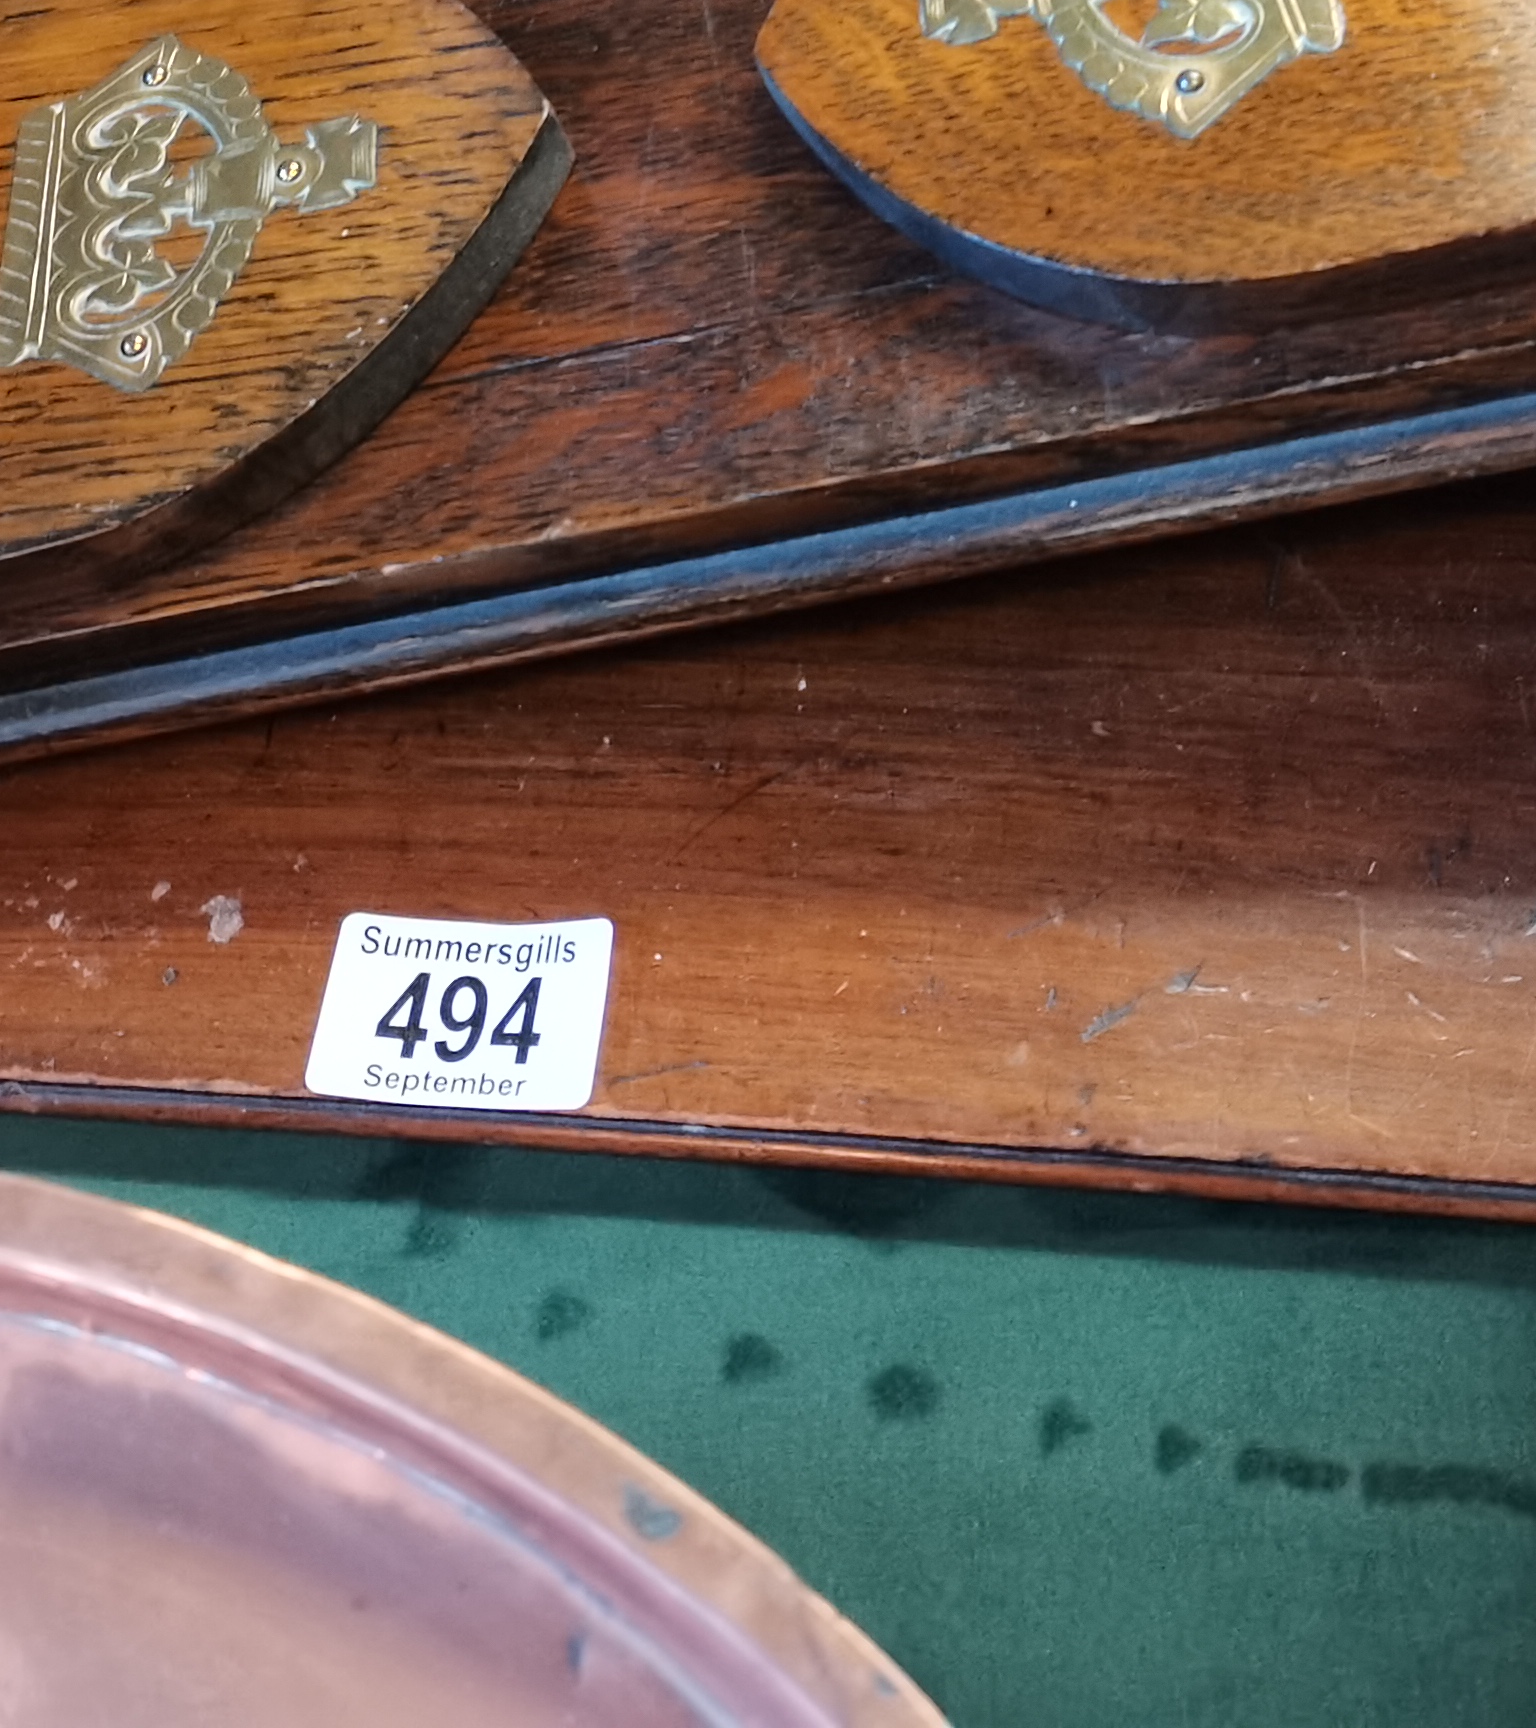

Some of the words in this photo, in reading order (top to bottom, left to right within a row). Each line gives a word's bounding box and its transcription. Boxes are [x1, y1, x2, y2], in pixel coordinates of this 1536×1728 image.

[360, 925, 577, 973] Summersgills
[374, 972, 543, 1065] 494
[363, 1064, 528, 1097] September
